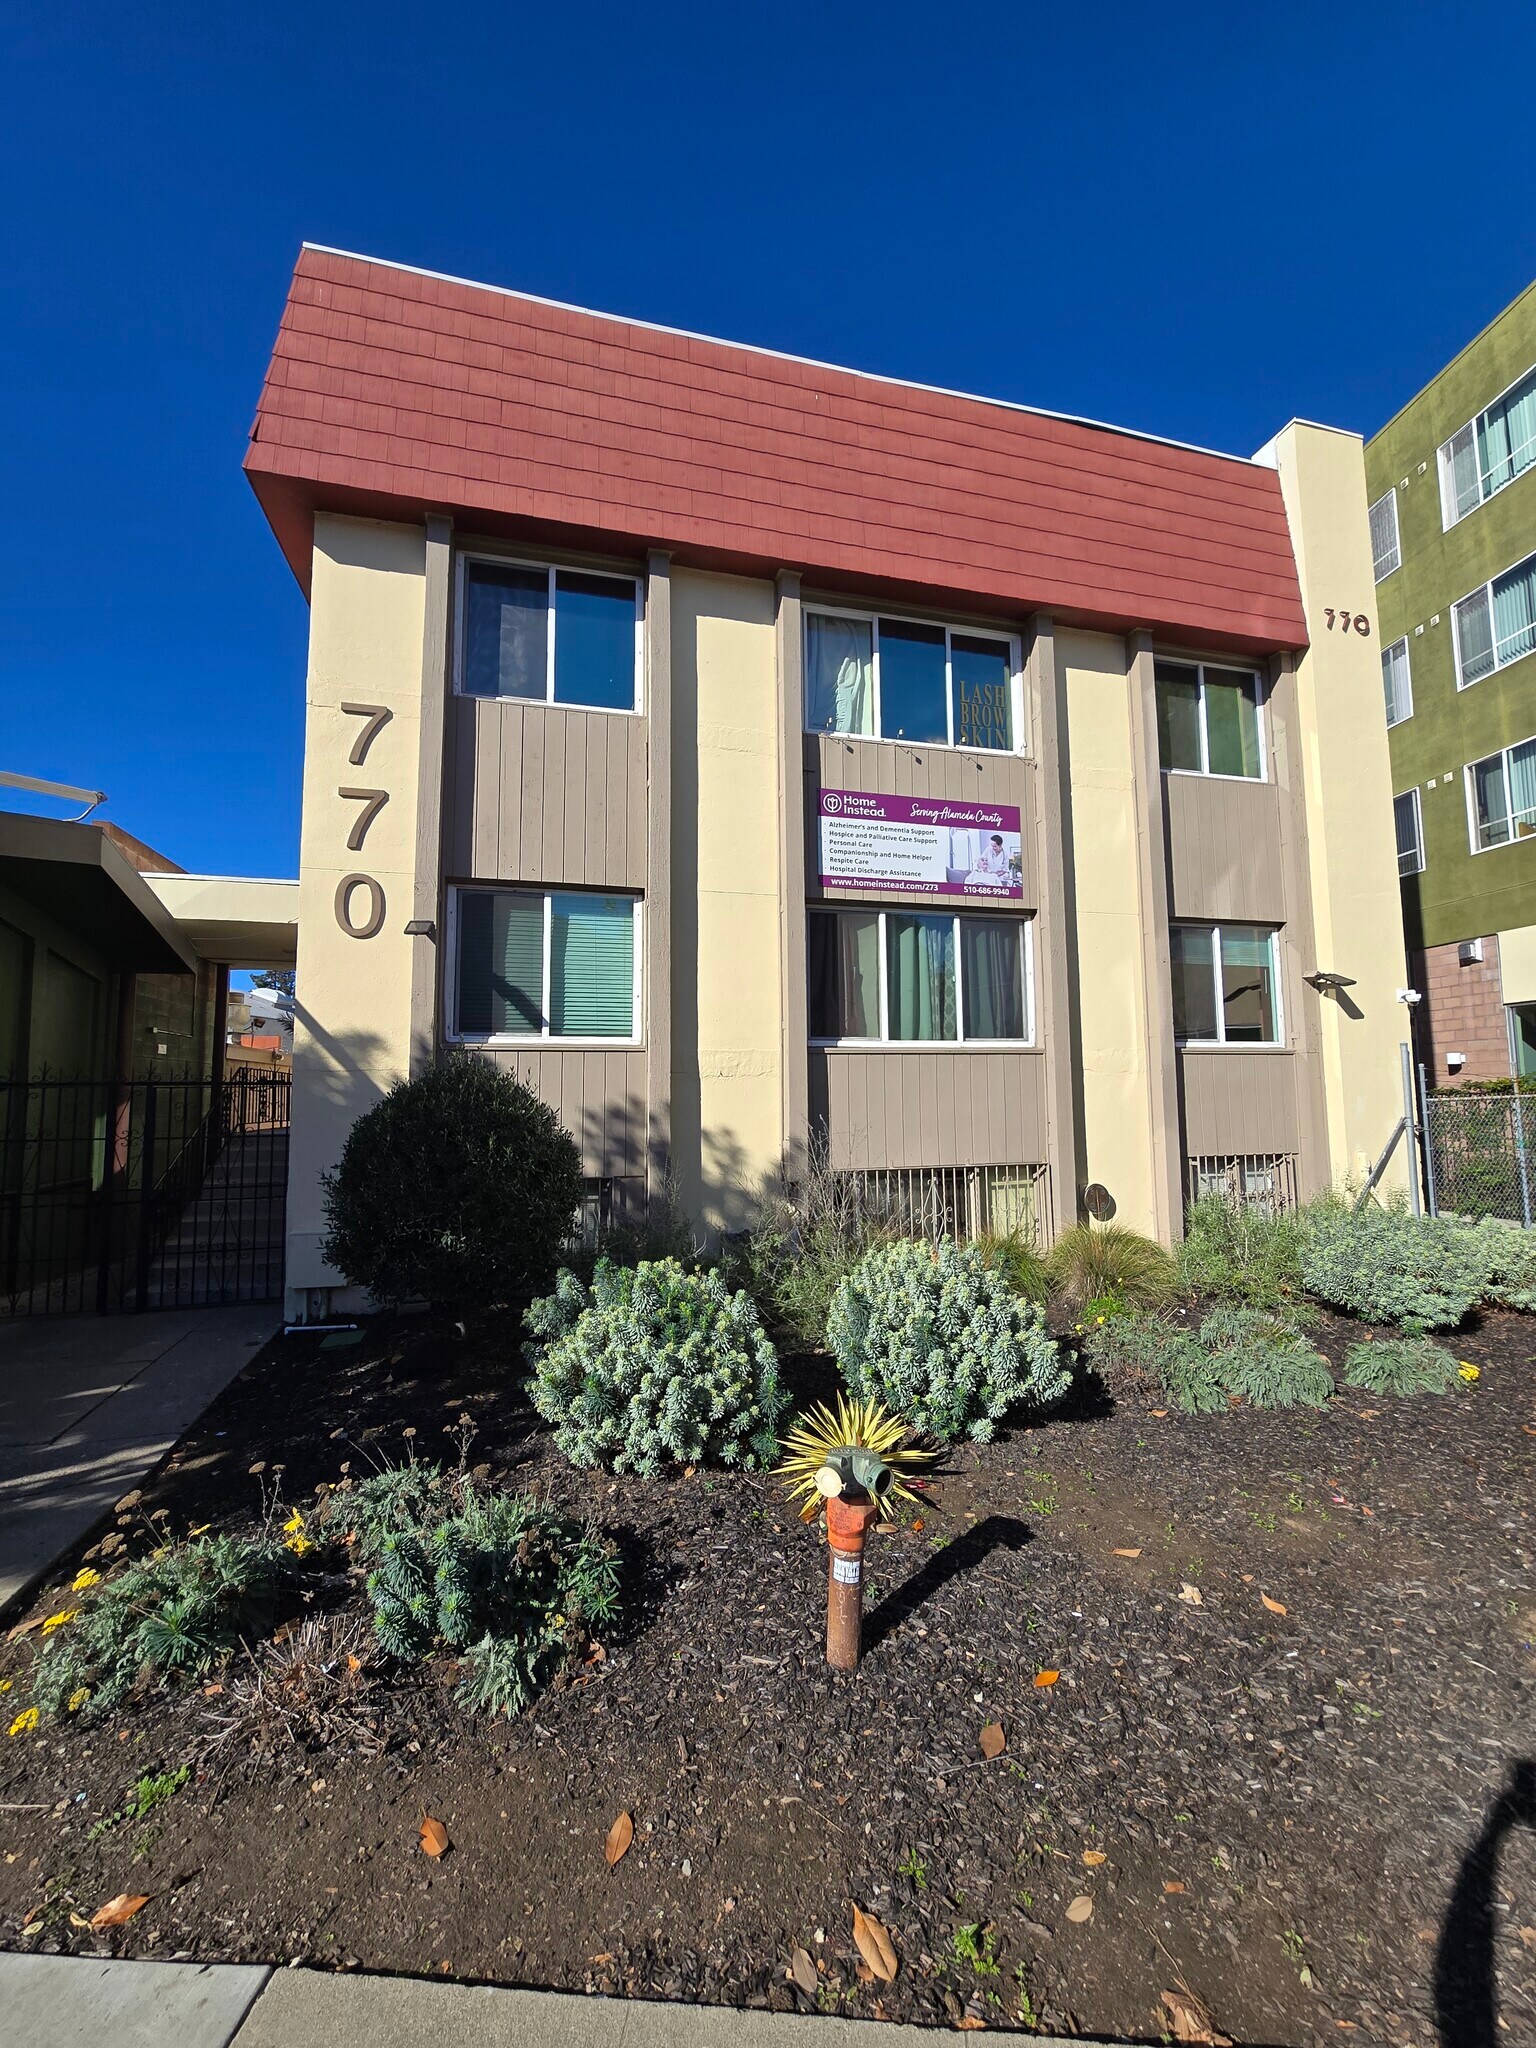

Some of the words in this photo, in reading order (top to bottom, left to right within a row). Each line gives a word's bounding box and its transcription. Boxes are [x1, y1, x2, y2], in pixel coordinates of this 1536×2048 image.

[1323, 607, 1370, 637] 770
[959, 680, 1006, 707] LASH
[960, 702, 1006, 729] BROW
[959, 724, 1006, 750] SKIN
[843, 795, 877, 807] Home
[910, 803, 940, 824] Serving
[940, 806, 975, 821] Alameda
[975, 809, 1004, 828] County
[829, 821, 866, 831] Alzheimer's
[879, 825, 910, 835] Dementia
[910, 828, 935, 836] Support
[829, 830, 855, 838] Hospice
[868, 833, 898, 842] Palliative
[898, 835, 913, 843] Care
[913, 837, 938, 845] Support
[829, 839, 857, 847] Personal
[829, 848, 878, 858] Companionship
[892, 852, 911, 860] Home
[829, 856, 854, 864] Respite
[829, 865, 857, 873] Hospital
[857, 867, 889, 876] Discharge
[889, 869, 922, 877] Assistance
[831, 878, 939, 891] www.homeinstead.com/273
[963, 885, 1010, 896] 510-686-9940
